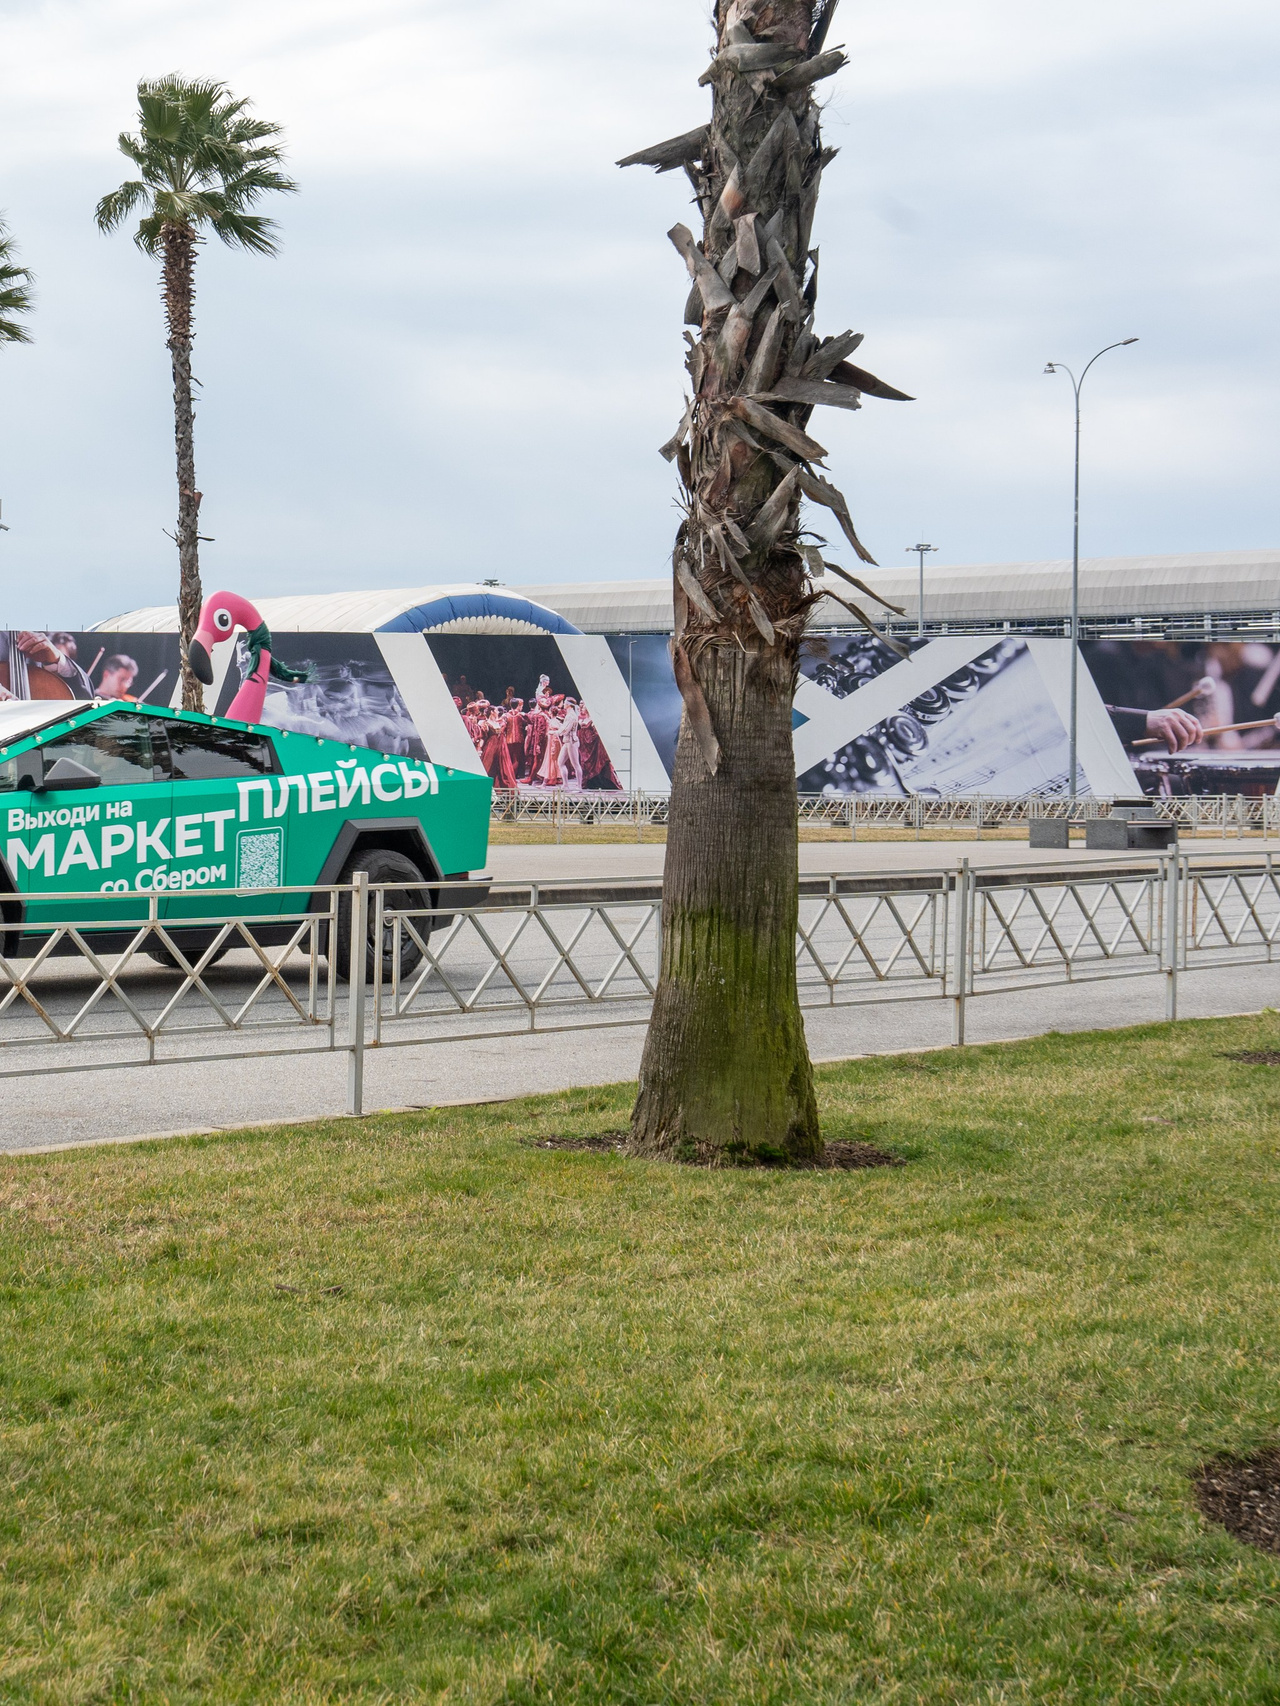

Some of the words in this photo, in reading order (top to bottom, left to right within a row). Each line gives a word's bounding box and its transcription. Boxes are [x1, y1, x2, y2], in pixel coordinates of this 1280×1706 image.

[6, 808, 236, 881] МАРКЕТ
[236, 758, 440, 822] ПЛЕЙСЫ
[7, 803, 100, 832] Выходи
[106, 800, 133, 819] на
[100, 879, 129, 892] со
[134, 863, 226, 891] Сбером
